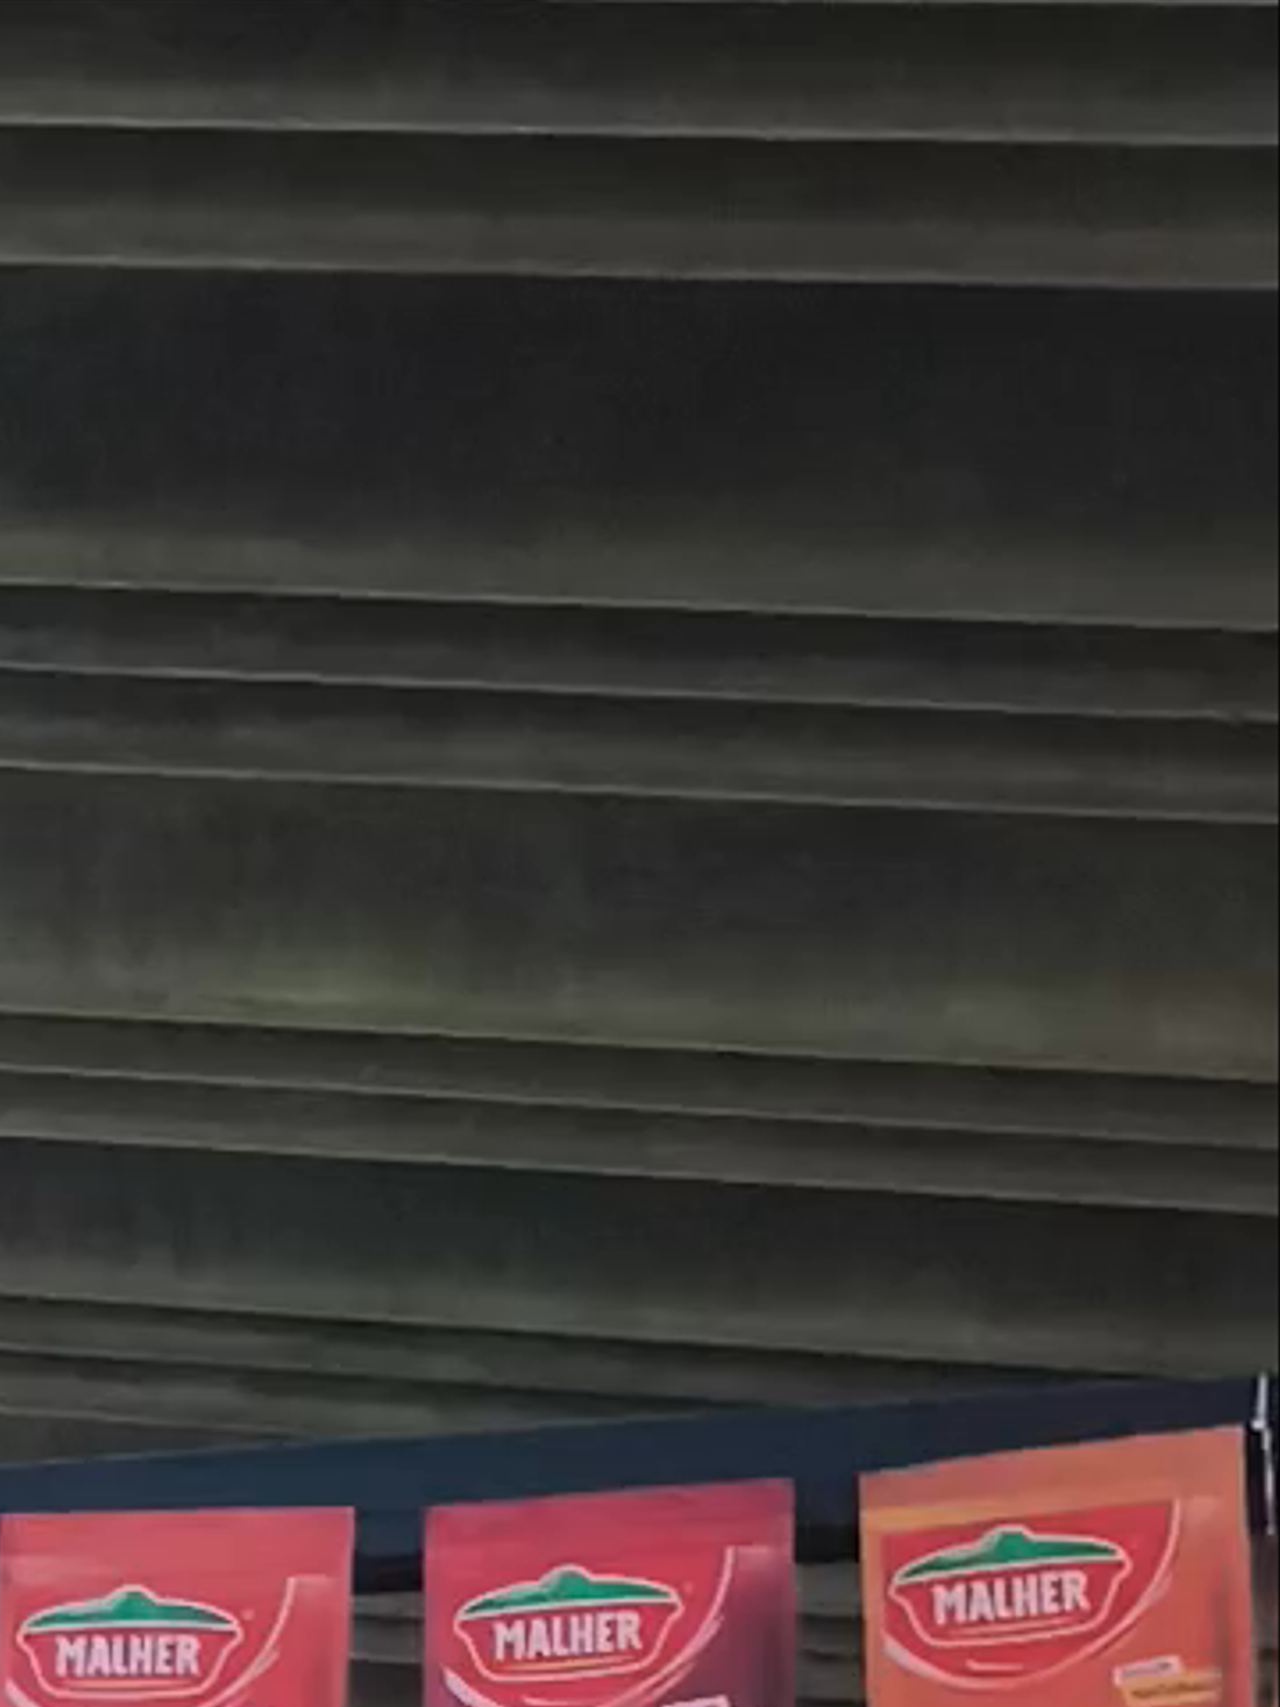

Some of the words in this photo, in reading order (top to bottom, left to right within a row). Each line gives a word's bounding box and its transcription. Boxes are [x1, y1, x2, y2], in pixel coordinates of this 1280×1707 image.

[931, 1570, 1091, 1624] MALHER
[55, 1635, 200, 1677] MALHER
[493, 1611, 642, 1660] MALHER
